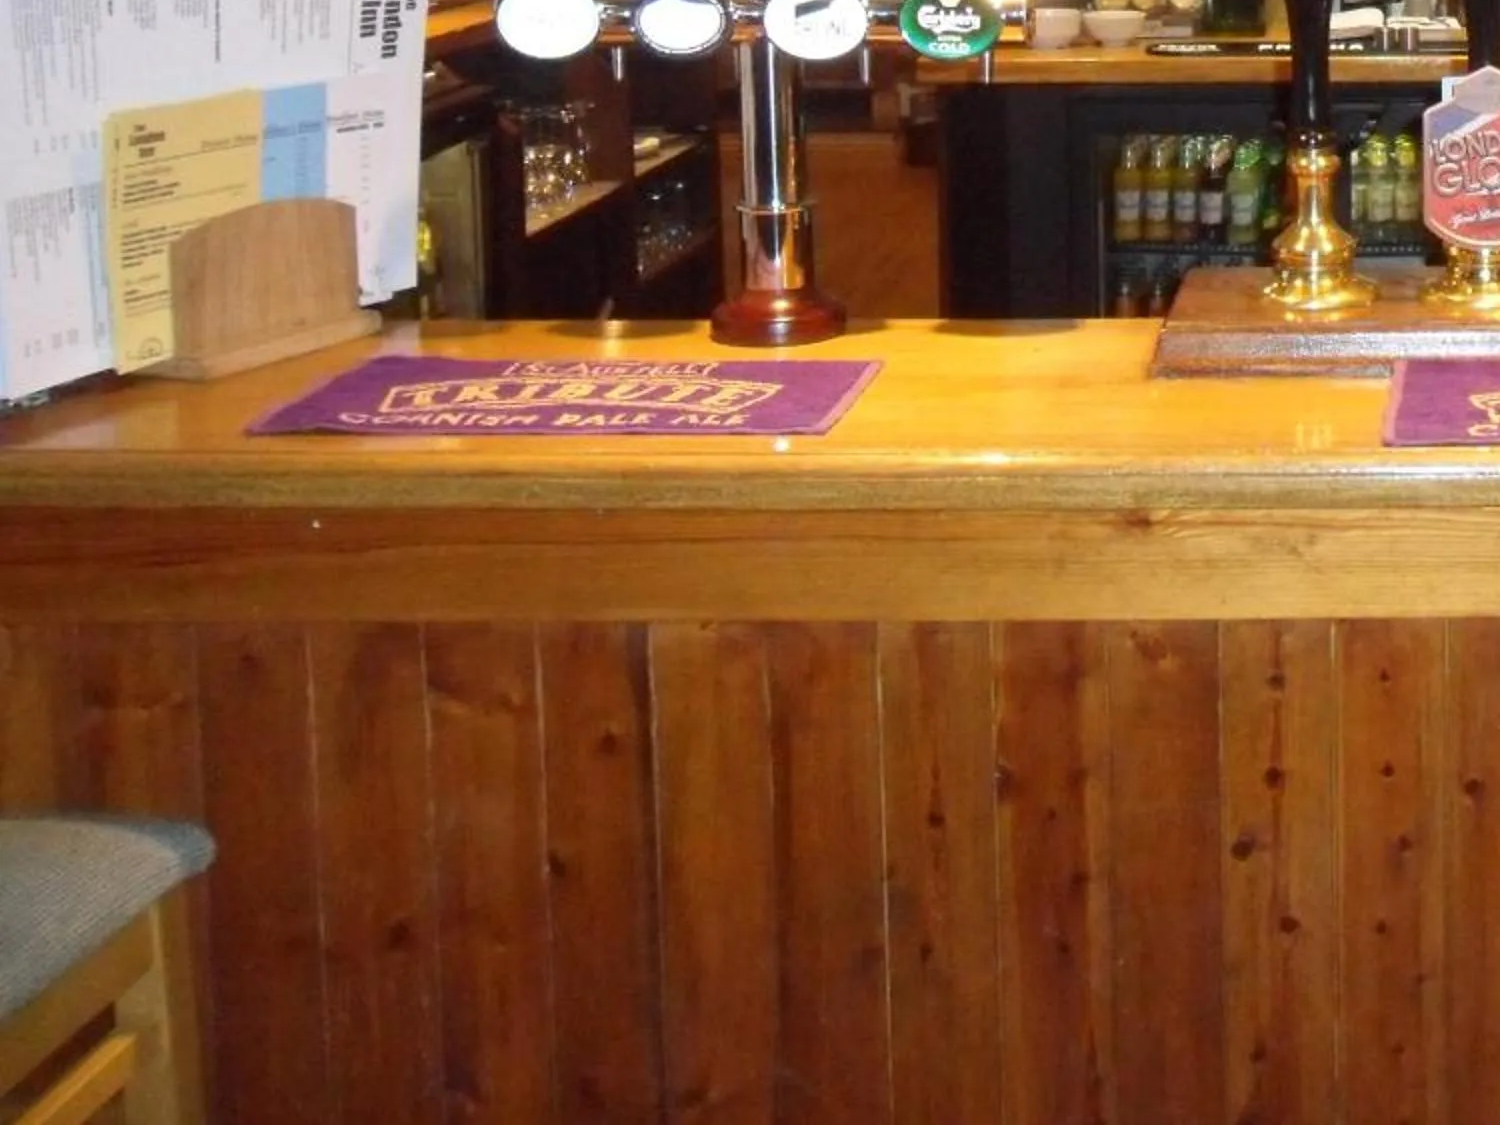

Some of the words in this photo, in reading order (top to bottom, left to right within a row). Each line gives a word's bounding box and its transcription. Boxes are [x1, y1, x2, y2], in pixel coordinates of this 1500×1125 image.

[360, 0, 382, 38] Inn
[402, 381, 755, 407] TRIBUTE
[553, 412, 657, 426] PALE
[670, 412, 751, 425] ALE
